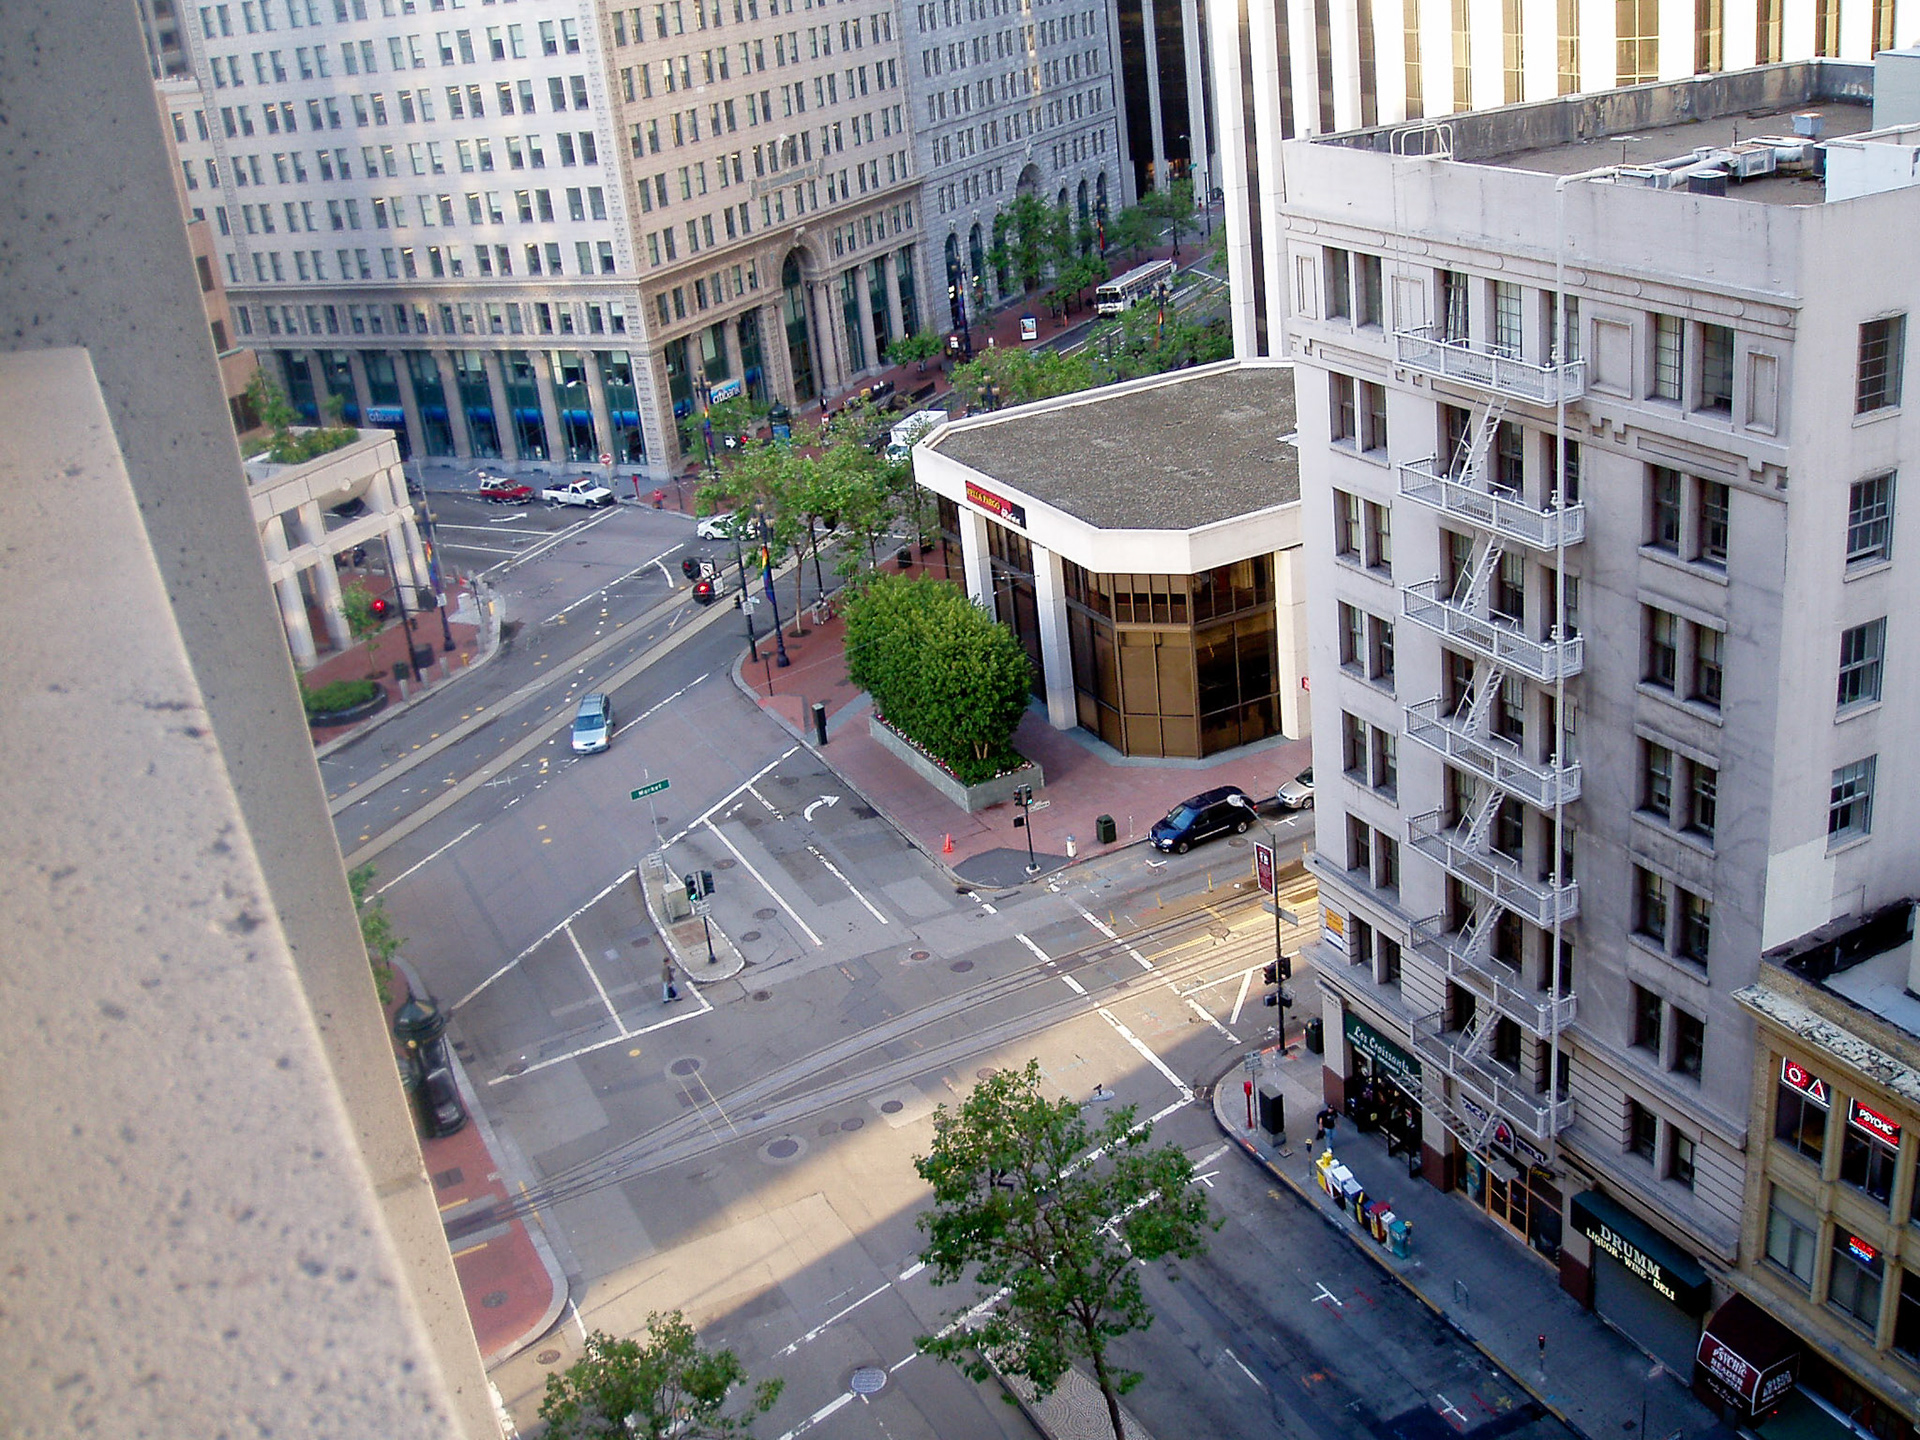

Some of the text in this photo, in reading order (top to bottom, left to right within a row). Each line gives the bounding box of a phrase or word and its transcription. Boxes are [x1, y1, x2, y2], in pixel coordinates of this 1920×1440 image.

[638, 783, 662, 796] Market
[1859, 1109, 1893, 1135] PSYCHIC
[1586, 1227, 1675, 1301] LIQUOR WINE DELI
[1600, 1224, 1661, 1281] DRUMM
[1710, 1358, 1743, 1387] READER
[1712, 1347, 1747, 1378] PSYCHIC
